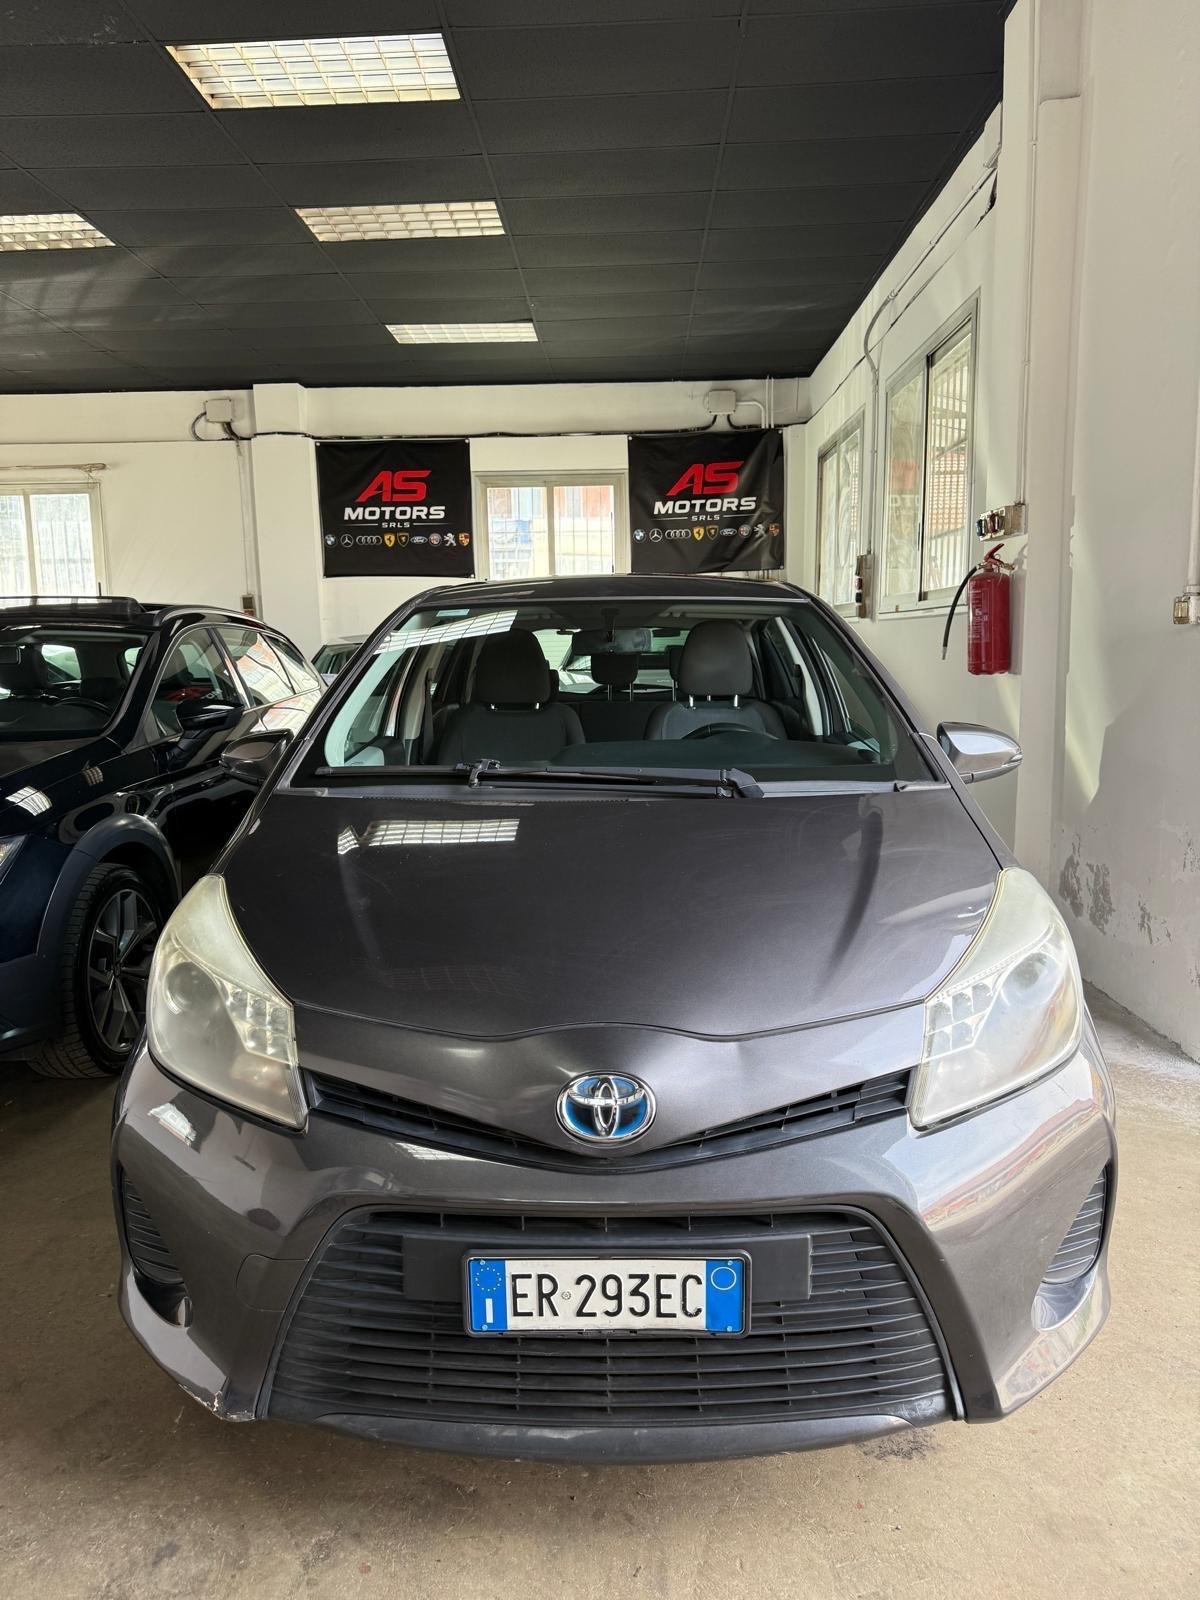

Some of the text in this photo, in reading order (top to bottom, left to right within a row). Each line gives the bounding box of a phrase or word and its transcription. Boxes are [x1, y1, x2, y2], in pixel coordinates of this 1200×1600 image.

[355, 470, 432, 502] AS
[665, 460, 745, 496] AS
[343, 505, 446, 520] MOTORS
[653, 497, 757, 515] MOTORS
[691, 514, 720, 522] SRLS
